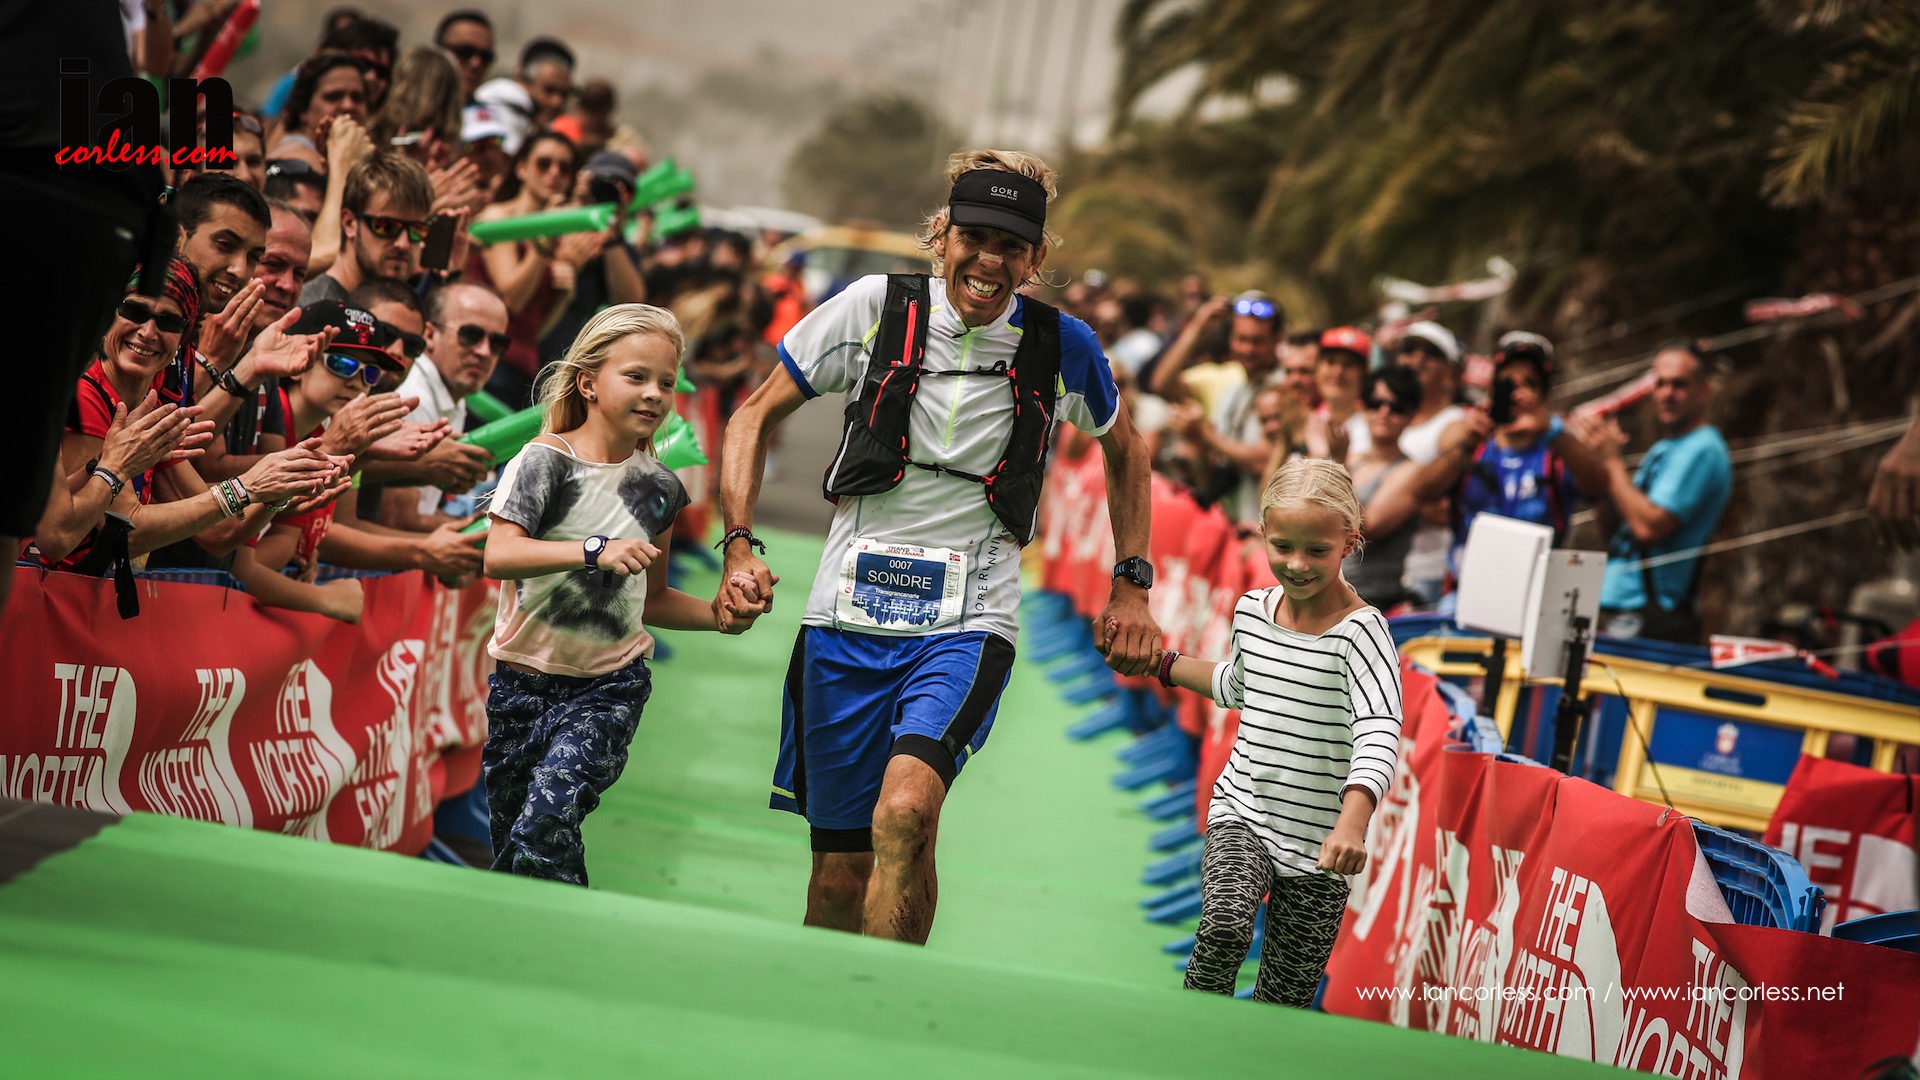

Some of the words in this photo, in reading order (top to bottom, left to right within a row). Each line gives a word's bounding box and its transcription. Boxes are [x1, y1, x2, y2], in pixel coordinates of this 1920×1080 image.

[990, 185, 1018, 198] GORE
[867, 570, 933, 590] SONDRE
[889, 559, 913, 570] 0007
[54, 663, 118, 749] THE
[179, 668, 233, 743] THE
[138, 746, 221, 822] NORTH
[250, 738, 330, 816] NORTH
[1537, 866, 1588, 963] THE
[1501, 948, 1569, 1053] ORTH
[1686, 937, 1741, 1062] THE
